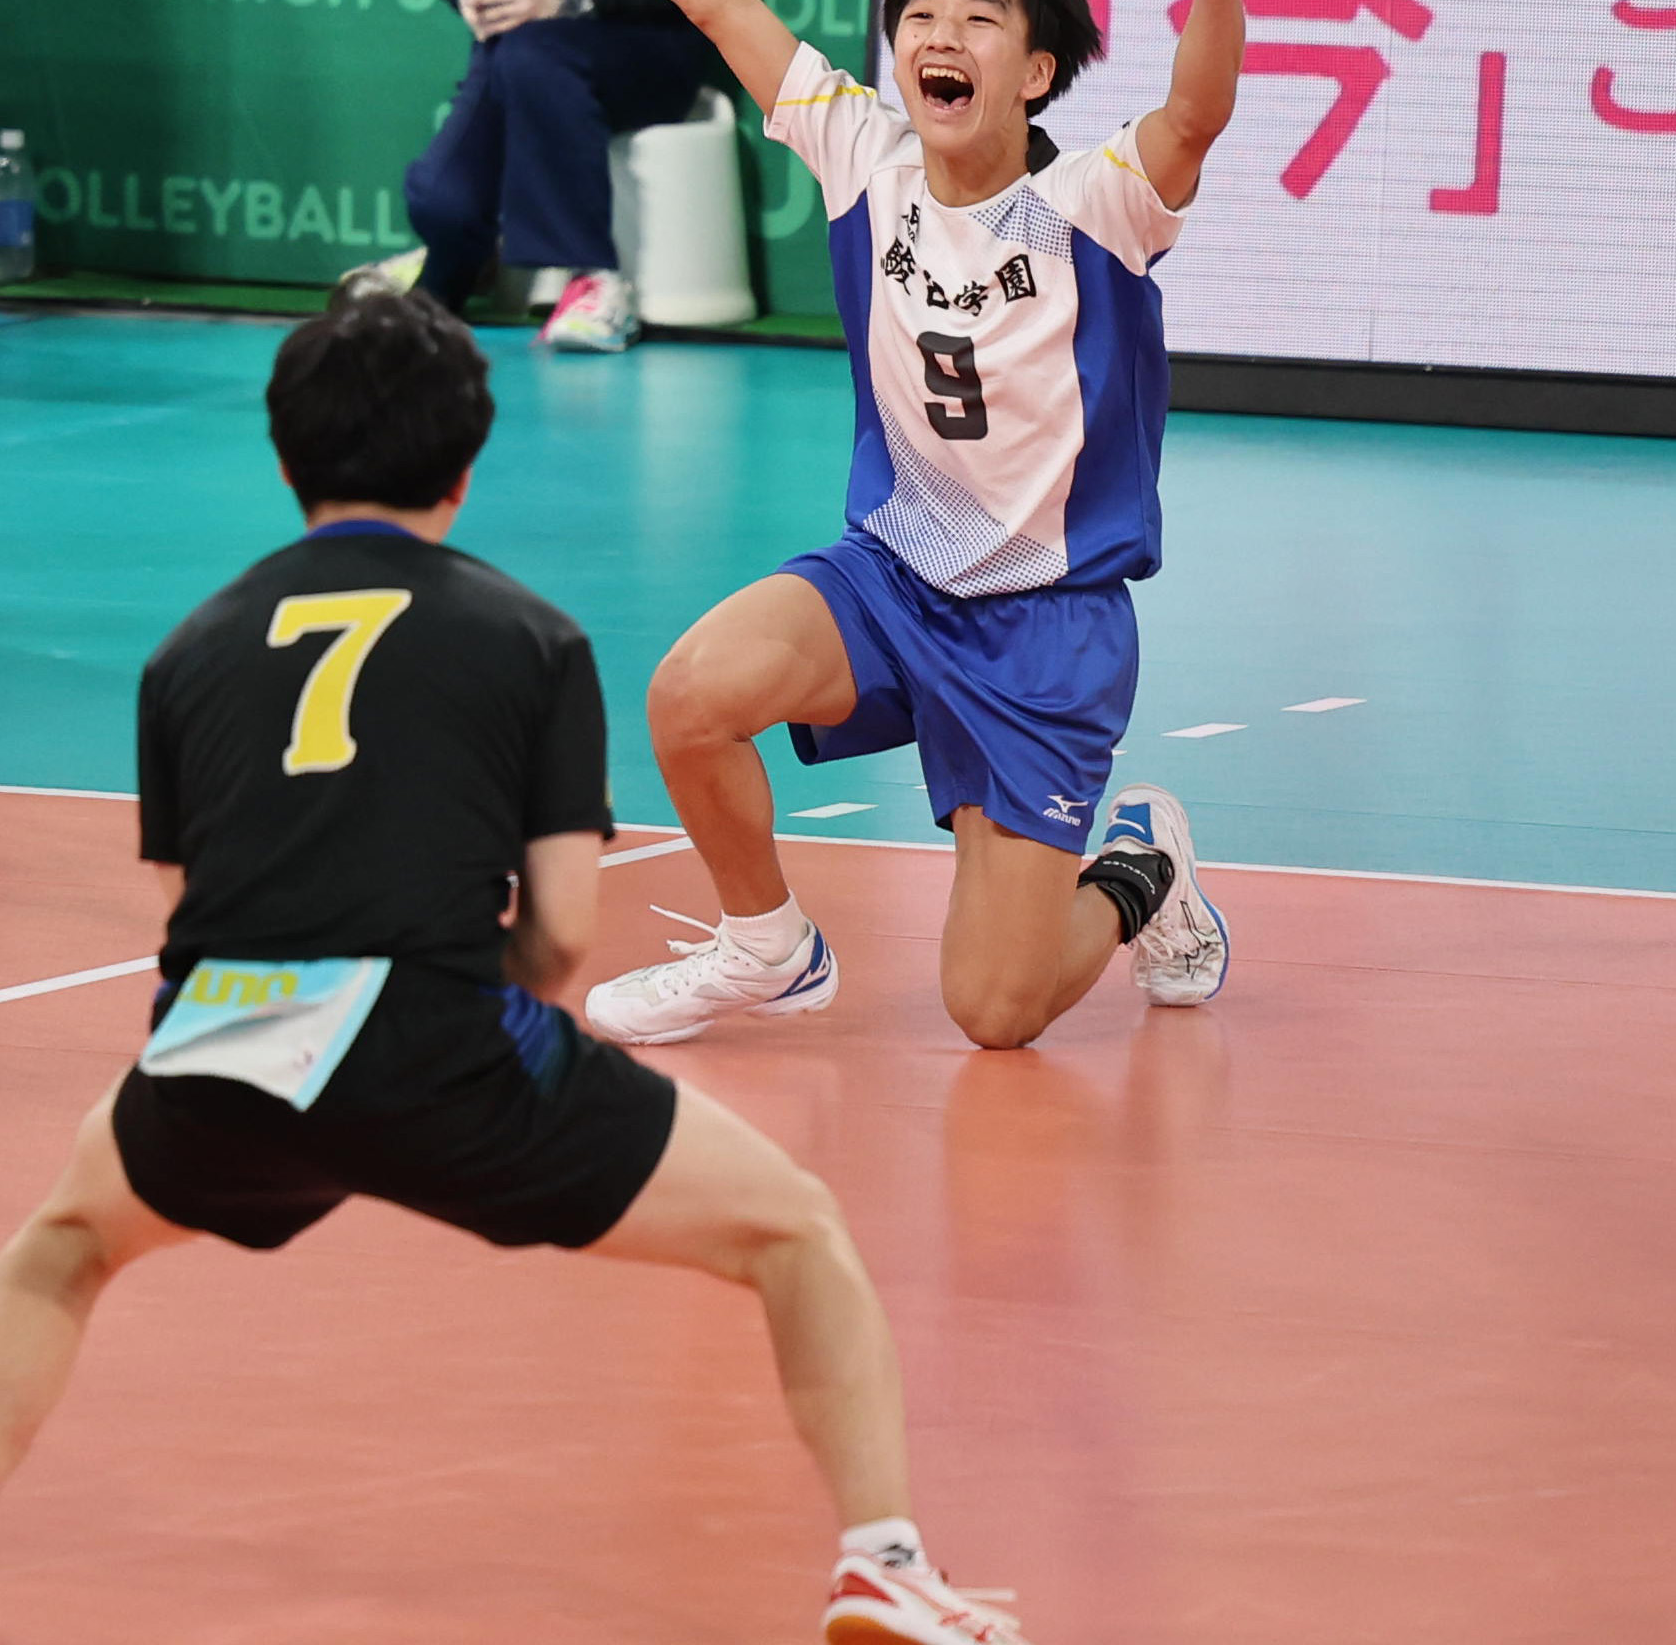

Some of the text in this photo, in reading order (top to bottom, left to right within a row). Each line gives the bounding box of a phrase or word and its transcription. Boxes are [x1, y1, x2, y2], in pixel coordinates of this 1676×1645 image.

[35, 166, 415, 247] OLLEYBALL
[915, 331, 989, 441] 9
[266, 587, 413, 778] 7
